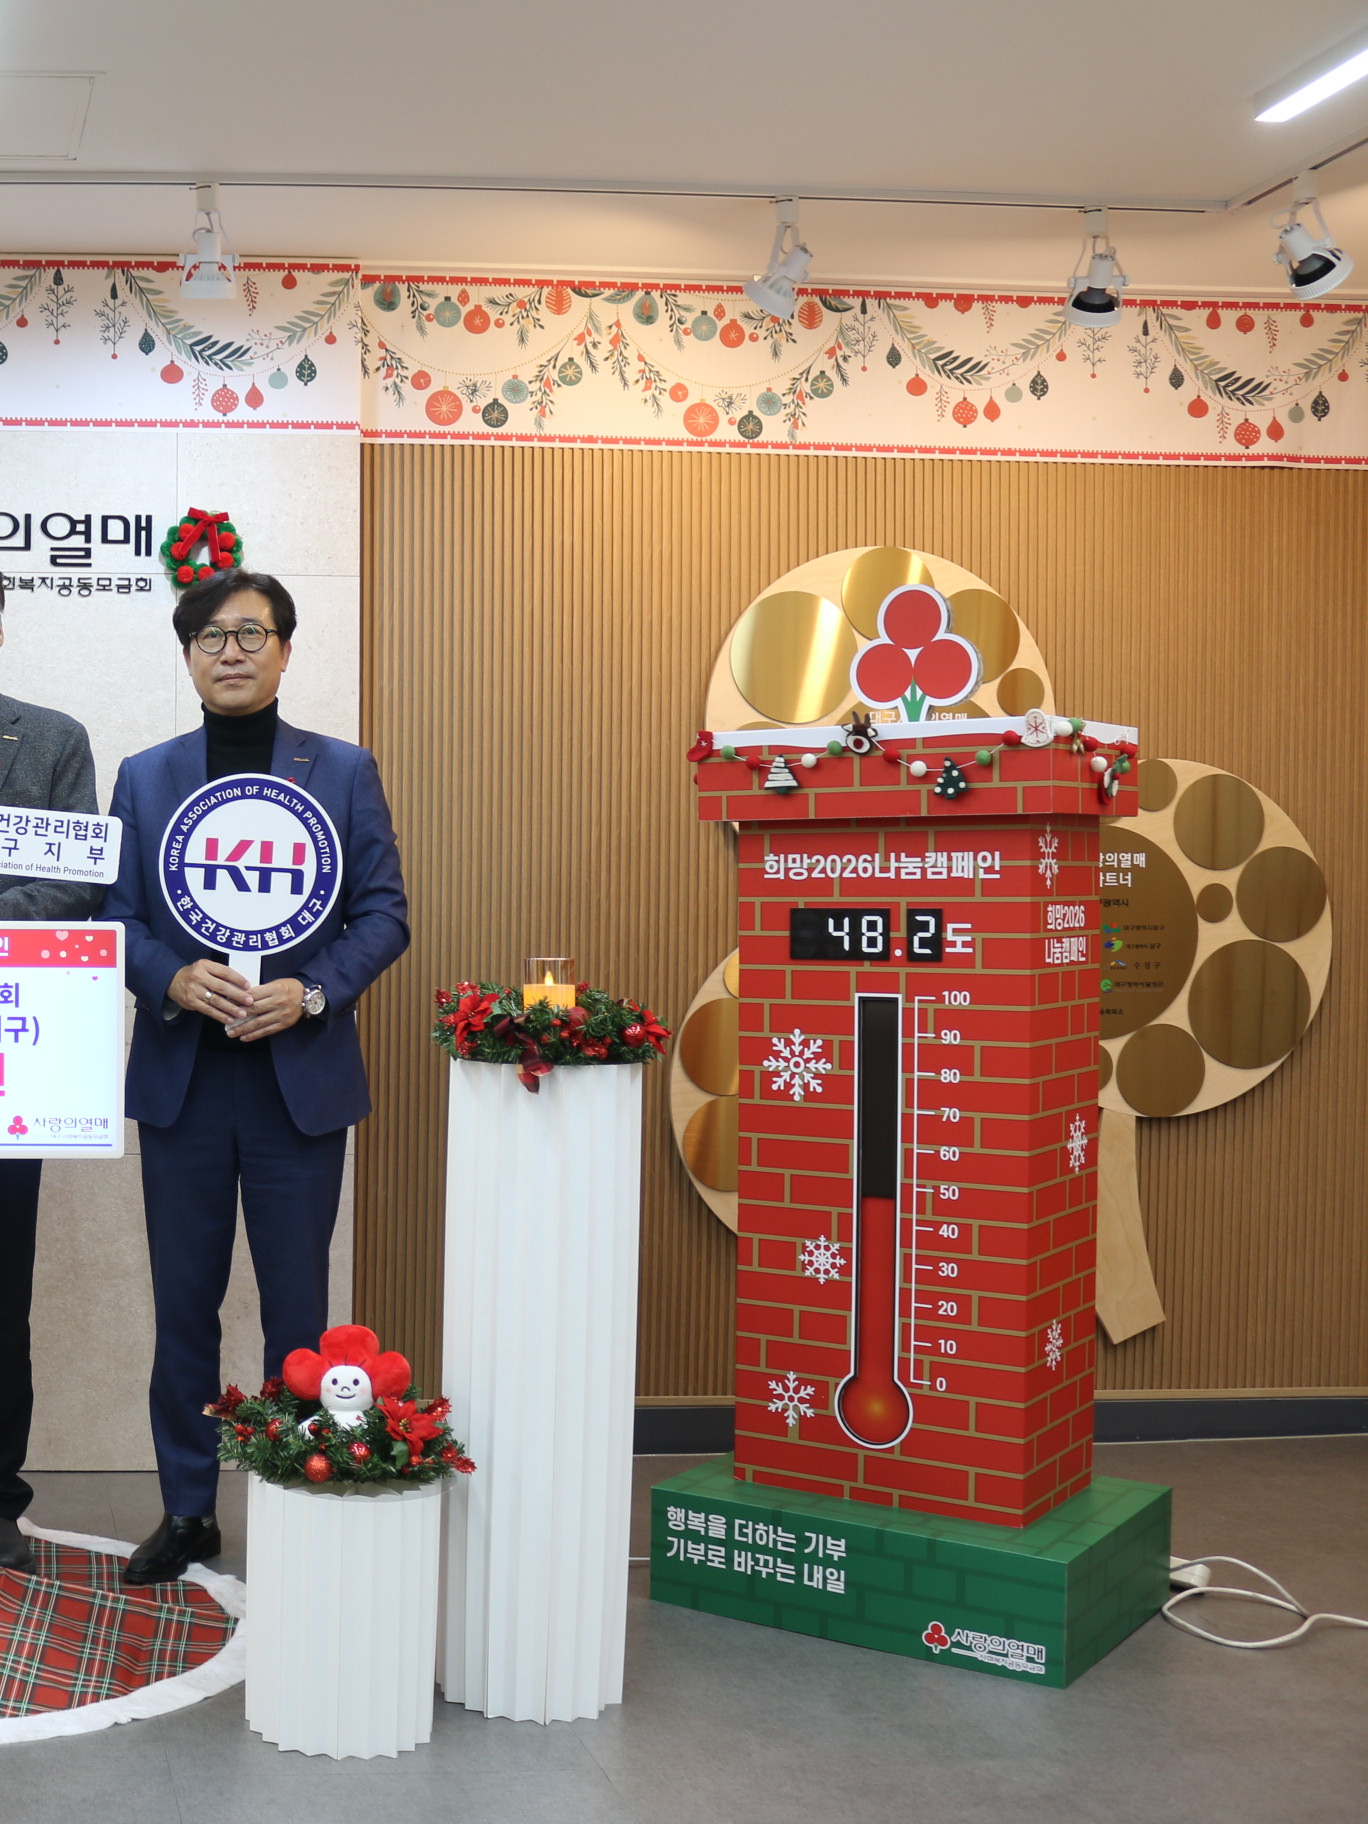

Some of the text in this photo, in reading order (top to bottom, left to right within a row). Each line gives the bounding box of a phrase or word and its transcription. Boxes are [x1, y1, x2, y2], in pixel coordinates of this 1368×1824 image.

[168, 785, 332, 873] KOREA ASSOCIATION OF HEALTH PROMOTION
[24, 860, 34, 871] of
[35, 862, 61, 874] Health
[63, 865, 104, 879] Promotion
[184, 837, 307, 895] KH
[764, 851, 1001, 880] 희망2026나눔캠페인
[176, 894, 326, 949] 한국건강관리협회 대구
[1046, 904, 1086, 930] 희망2026
[1045, 937, 1087, 964] 나눔캠페인
[942, 991, 970, 1006] 100
[940, 1029, 961, 1044] 90
[940, 1069, 960, 1083] 80
[940, 1107, 960, 1122] 70
[33, 1117, 109, 1133] 사랑의열매
[939, 1146, 959, 1161] 60
[939, 1185, 959, 1200] 50
[938, 1224, 959, 1239] 40
[938, 1262, 958, 1277] 30
[937, 1300, 958, 1316] 20
[938, 1339, 957, 1354] 10
[936, 1377, 947, 1392] 0
[666, 1506, 847, 1561] 행복을 더하는 기부
[666, 1536, 845, 1594] 기부로 바꾸는 내일
[952, 1629, 1044, 1661] 사랑의열매
